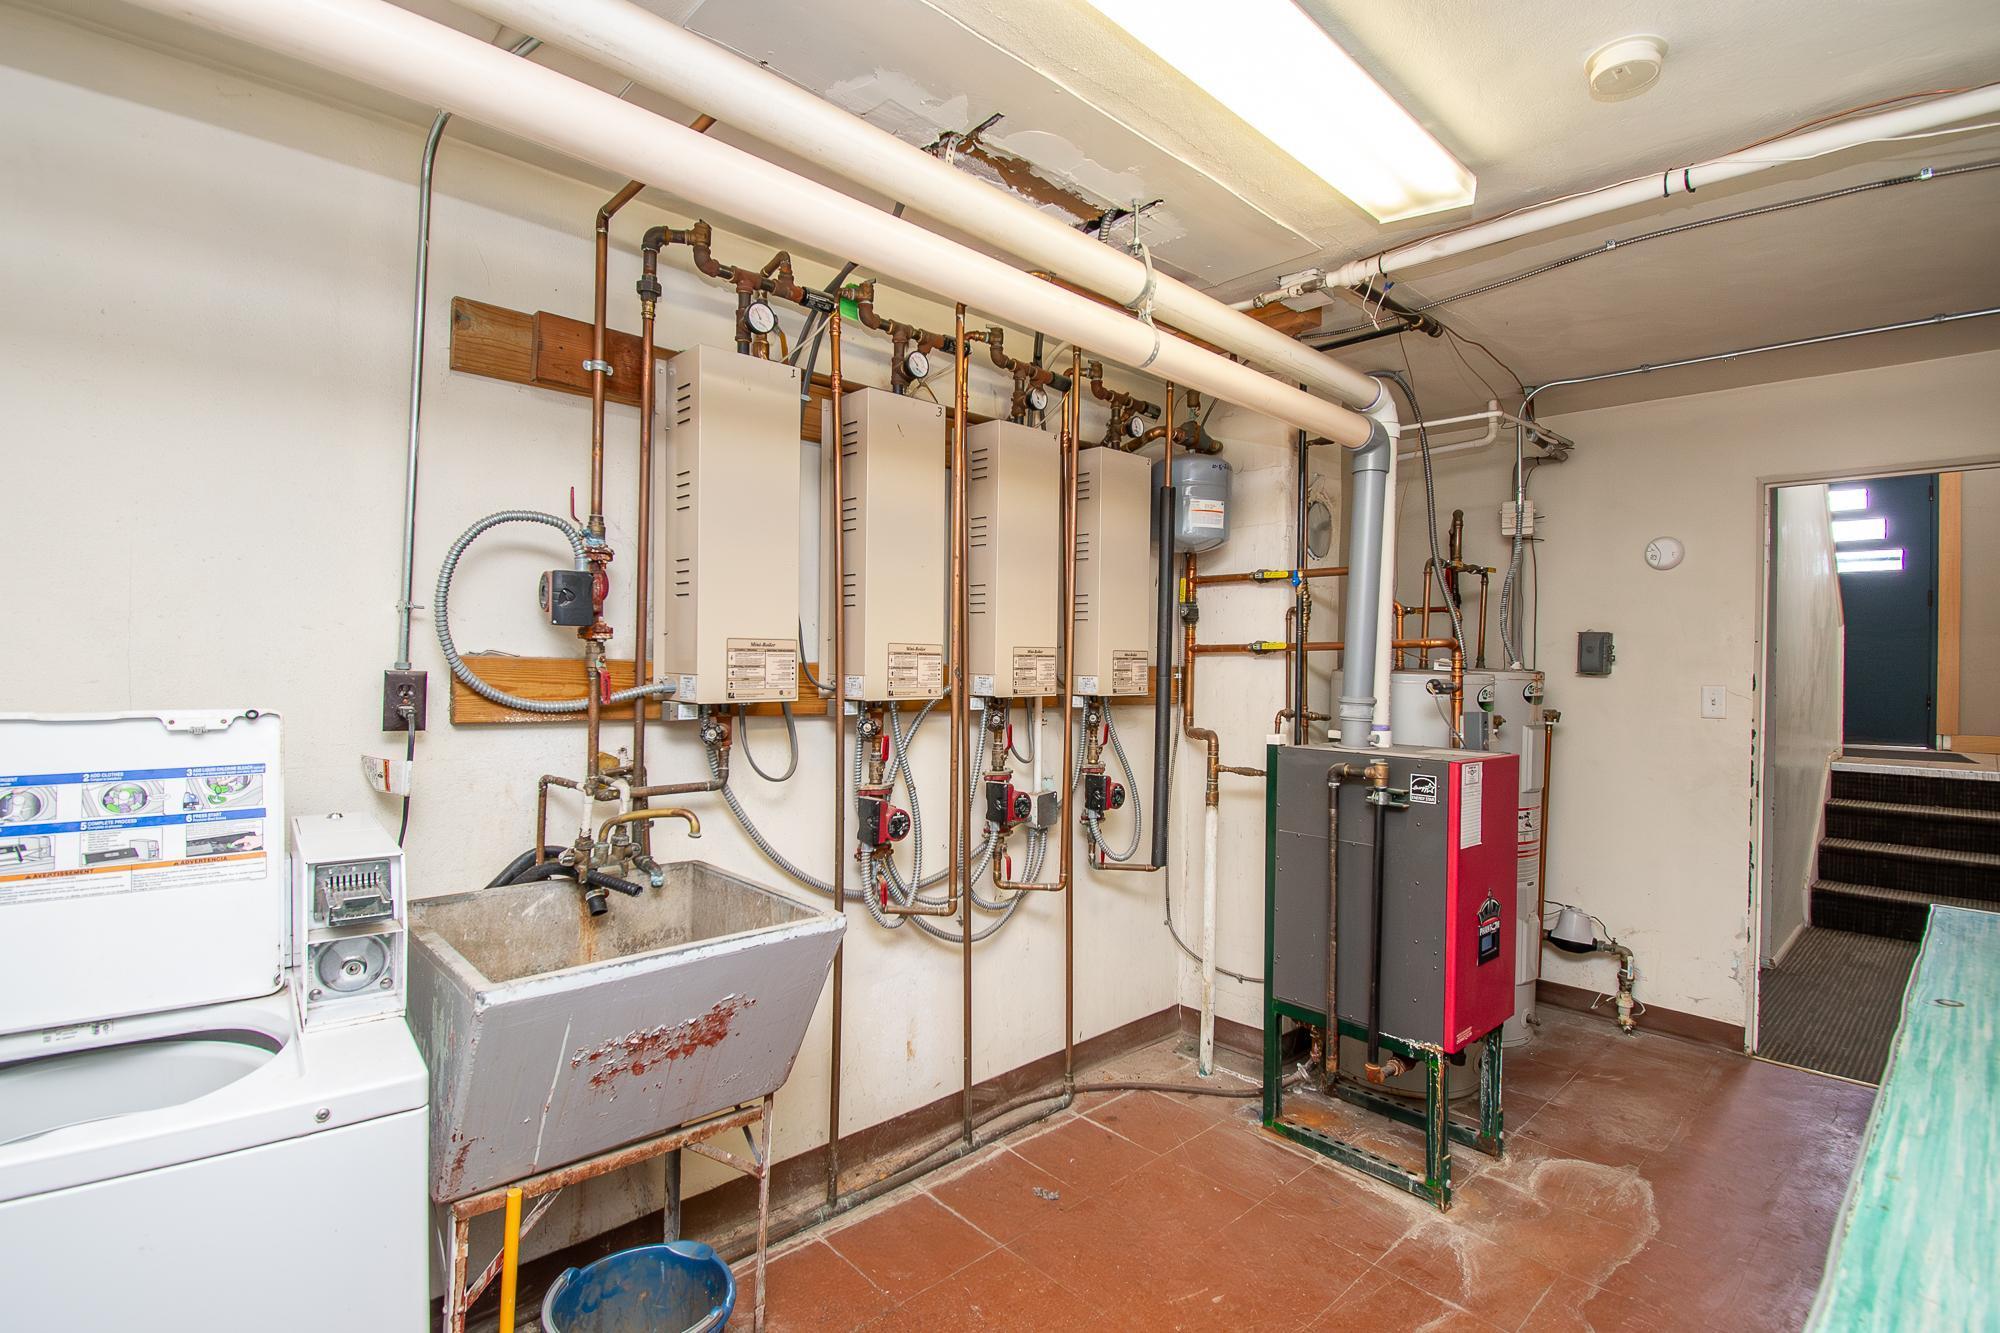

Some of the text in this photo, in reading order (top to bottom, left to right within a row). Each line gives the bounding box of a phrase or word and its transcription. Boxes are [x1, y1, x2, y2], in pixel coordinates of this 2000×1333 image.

[935, 406, 943, 418] 3
[186, 768, 193, 777] 3
[83, 773, 90, 782] 2
[185, 814, 192, 823] 6
[80, 821, 87, 831] 5
[180, 856, 228, 865] ADVERTENCIA
[32, 868, 94, 879] AVERTISSEMENT
